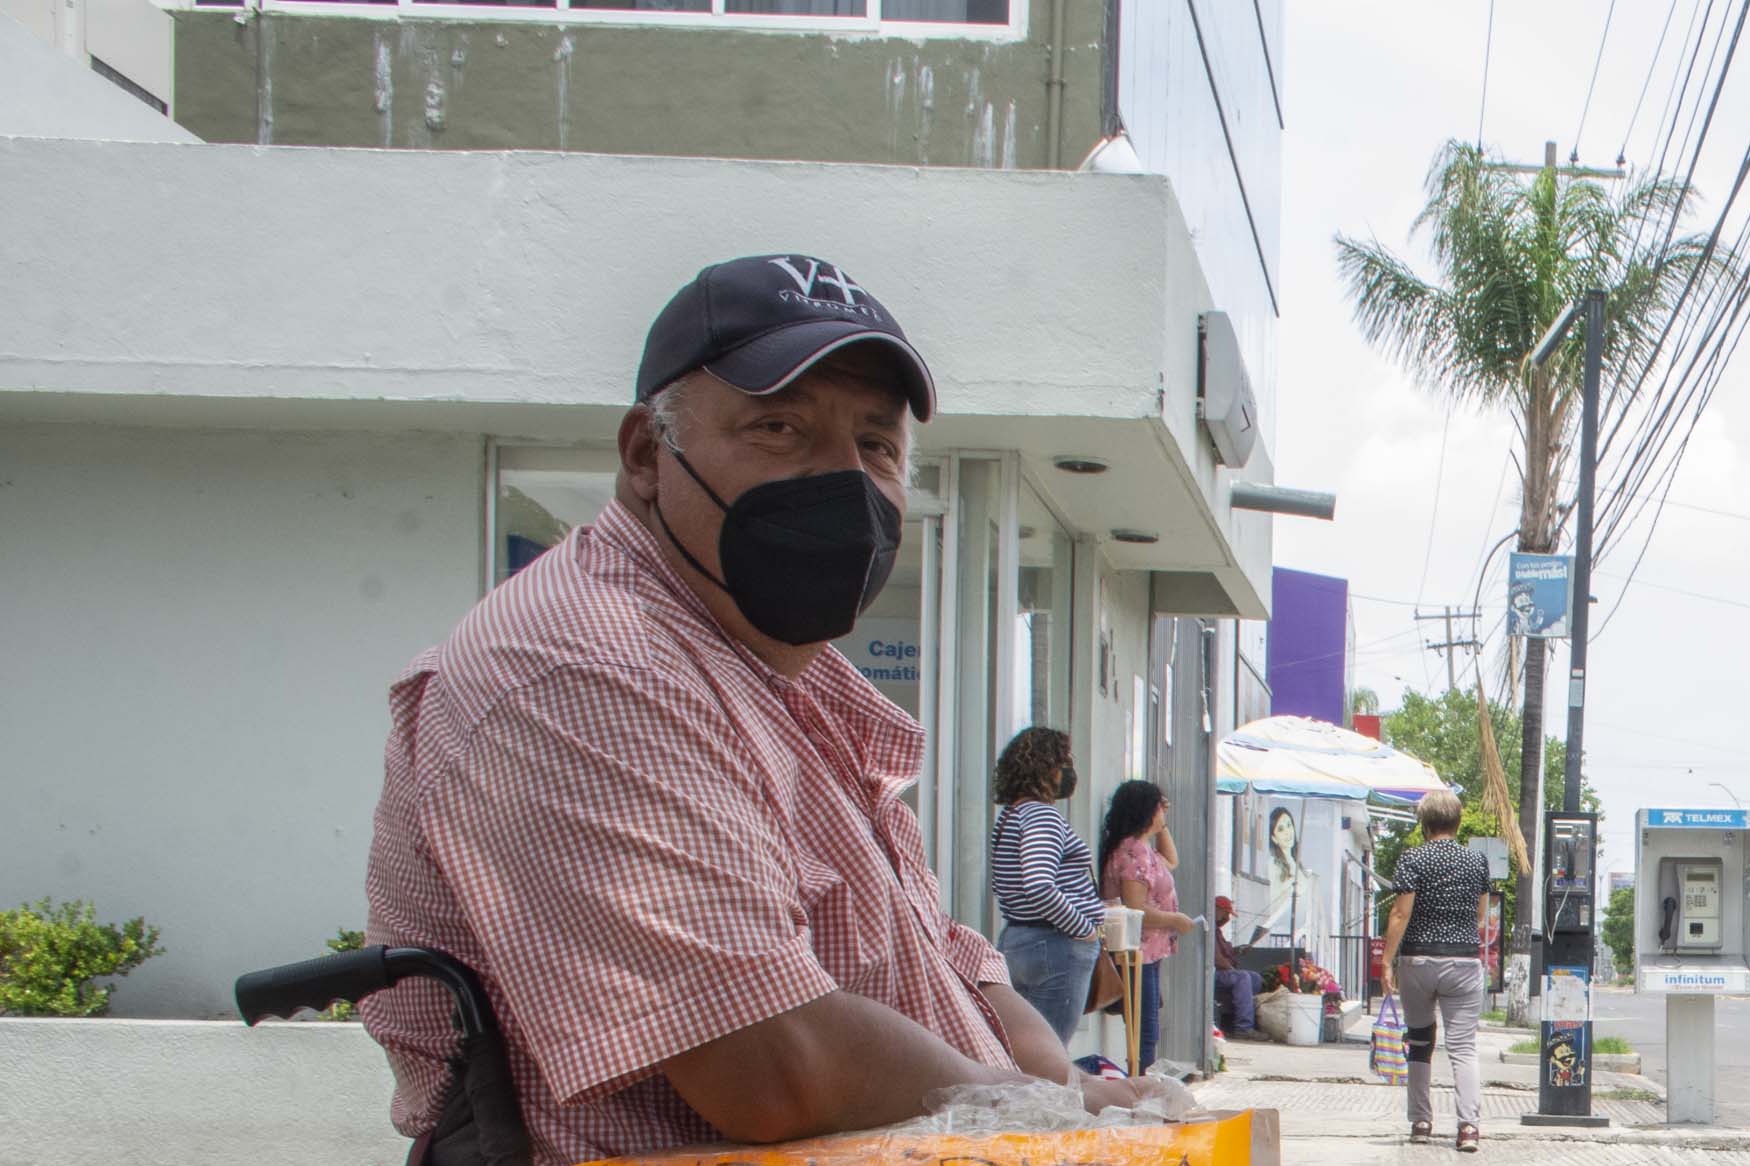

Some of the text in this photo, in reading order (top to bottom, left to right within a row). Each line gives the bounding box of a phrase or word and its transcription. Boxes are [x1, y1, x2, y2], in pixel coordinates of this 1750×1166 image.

[856, 665, 921, 681] omáti
[1686, 814, 1733, 823] TELMEX
[1664, 974, 1726, 985] infinitum
